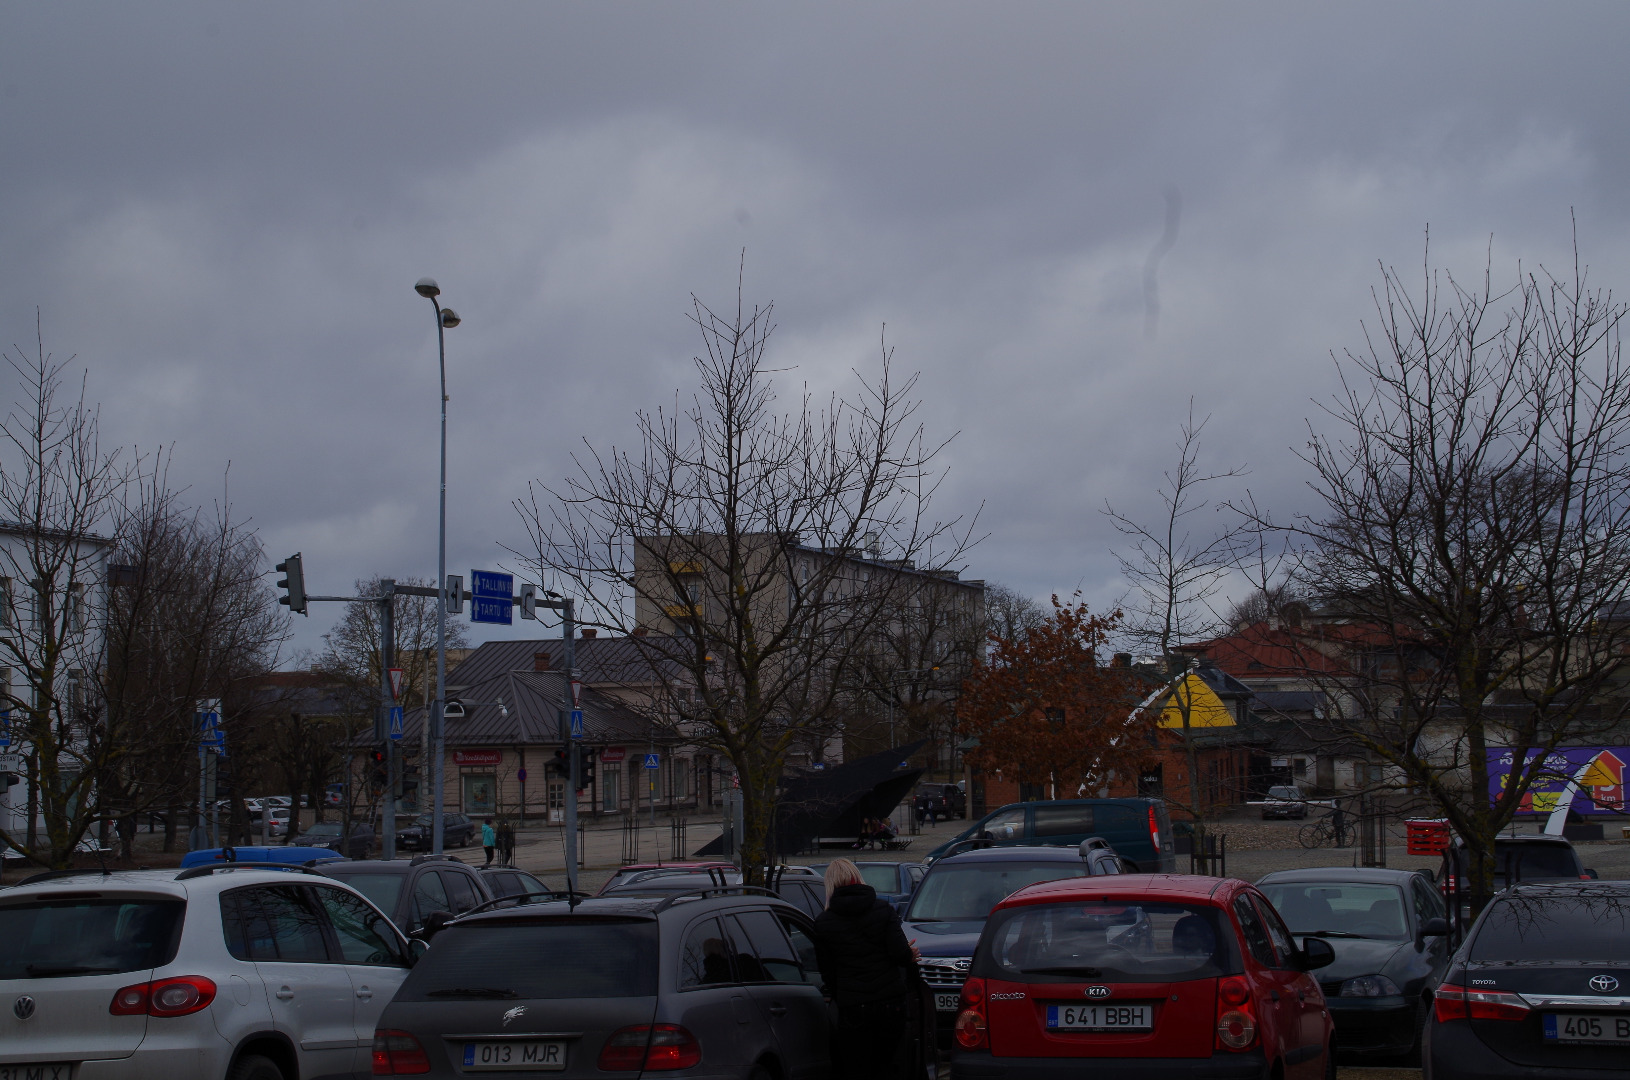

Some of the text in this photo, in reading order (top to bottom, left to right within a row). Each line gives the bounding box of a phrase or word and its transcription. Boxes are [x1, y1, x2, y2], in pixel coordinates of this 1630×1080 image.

[481, 578, 506, 592] TALLINN
[480, 603, 501, 617] TARTU
[1601, 793, 1616, 802] km
[990, 991, 1026, 1003] picanto
[1088, 987, 1107, 997] KIA
[938, 995, 960, 1008] 969
[1064, 1007, 1097, 1025] 641
[1105, 1007, 1144, 1025] BBH
[1545, 1017, 1630, 1038] EST 405 B
[481, 1044, 512, 1063] 013
[522, 1044, 560, 1063] MJR
